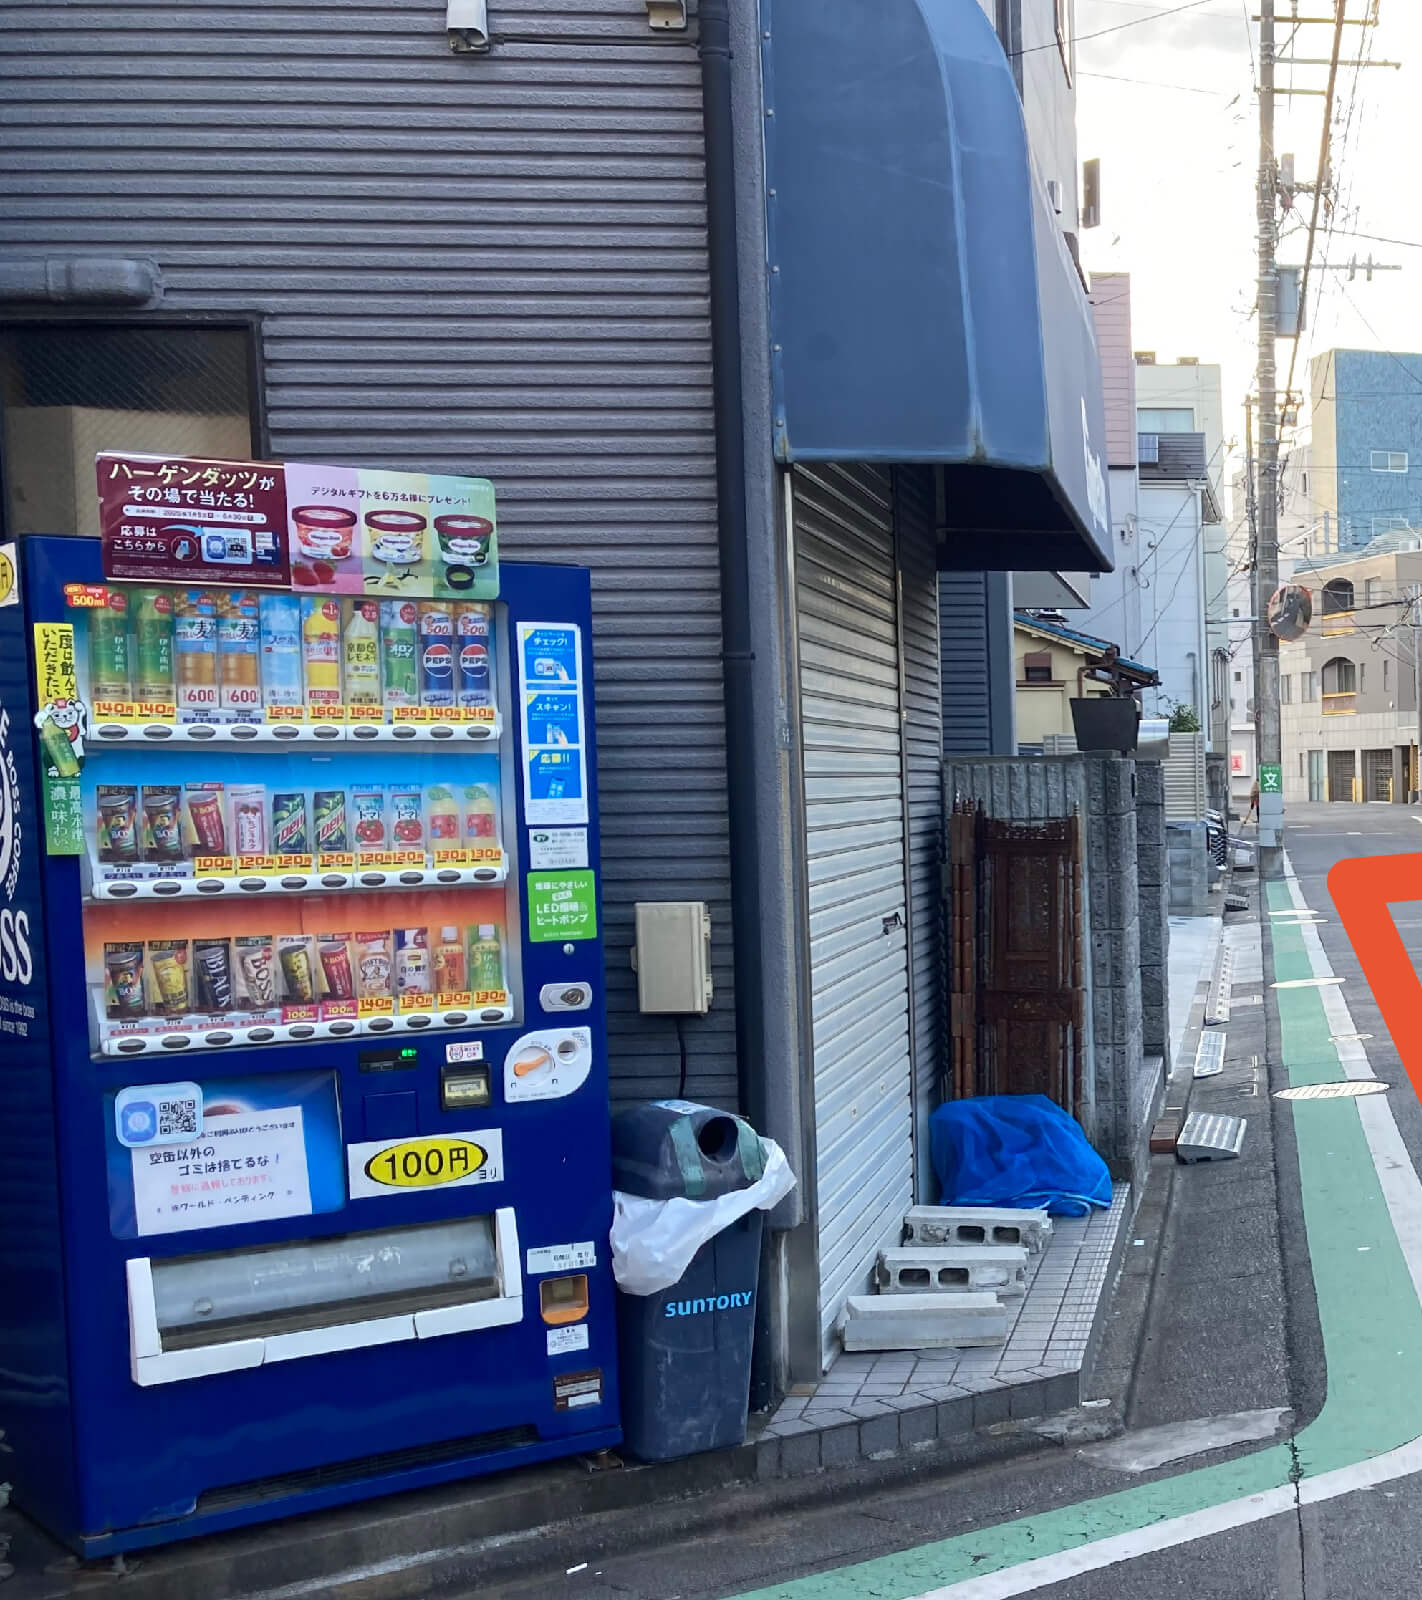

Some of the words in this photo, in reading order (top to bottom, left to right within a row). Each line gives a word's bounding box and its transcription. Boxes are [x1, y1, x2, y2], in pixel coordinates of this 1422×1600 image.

[109, 463, 275, 490] ハーゲンダッツが
[113, 539, 166, 552] こちらから
[42, 629, 60, 698] いただきたい
[251, 957, 273, 1002] BOSS
[149, 1146, 215, 1166] 空缶以外の
[384, 1146, 469, 1181] 100円
[479, 1168, 497, 1180] ヨリ
[664, 1290, 752, 1318] SUNTORY
